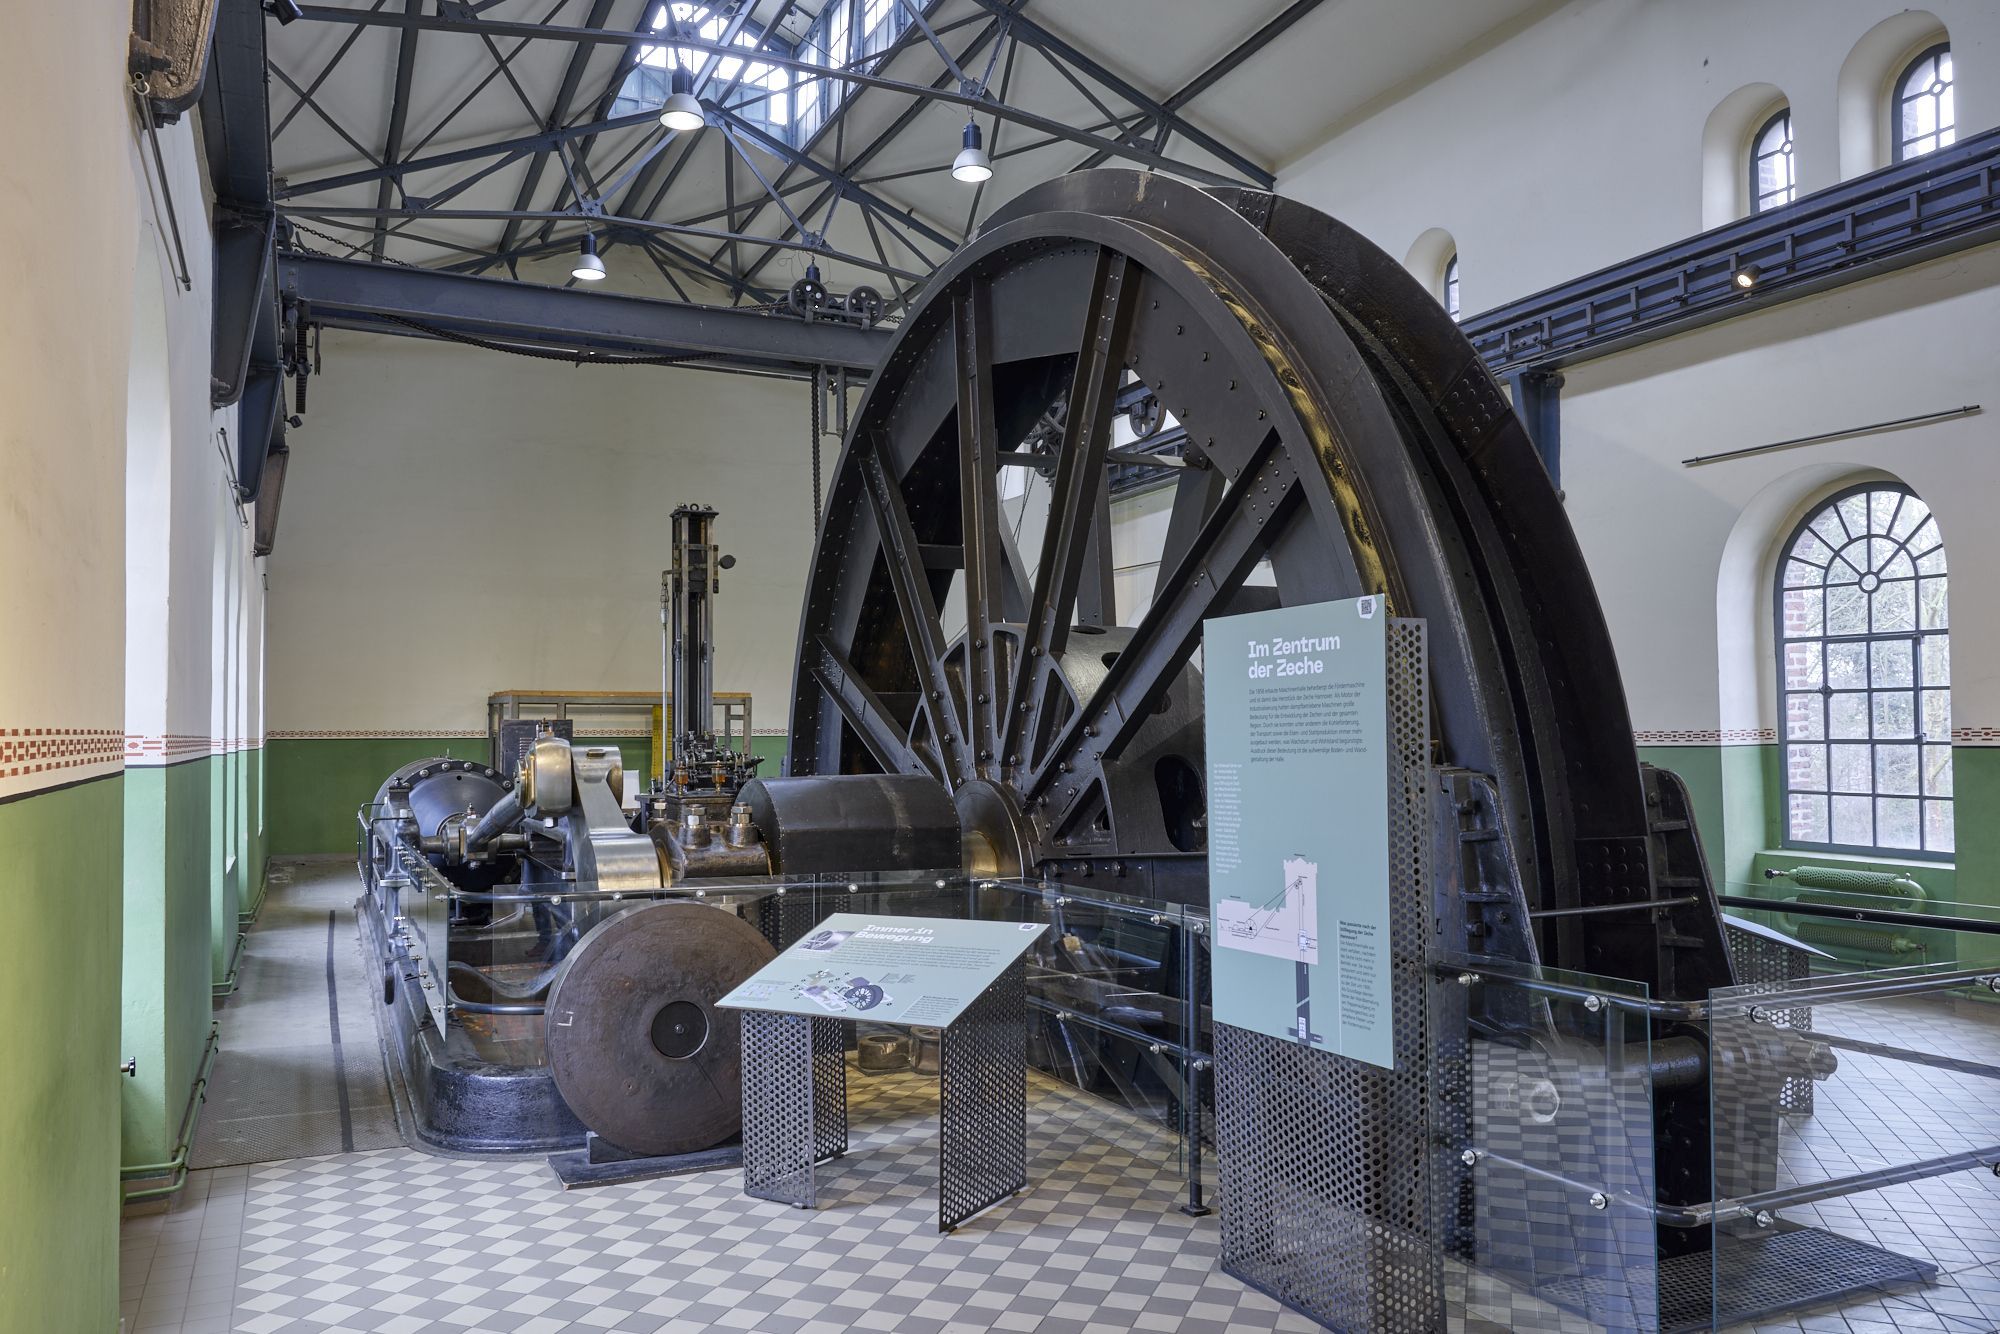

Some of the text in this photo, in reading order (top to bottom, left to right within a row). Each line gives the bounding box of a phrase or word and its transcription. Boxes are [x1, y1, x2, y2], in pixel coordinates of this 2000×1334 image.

[1248, 635, 1340, 658] Im Zentrum
[1248, 656, 1323, 679] der Zeche
[854, 931, 935, 944] Bewegung
[862, 924, 933, 935] Immer in
